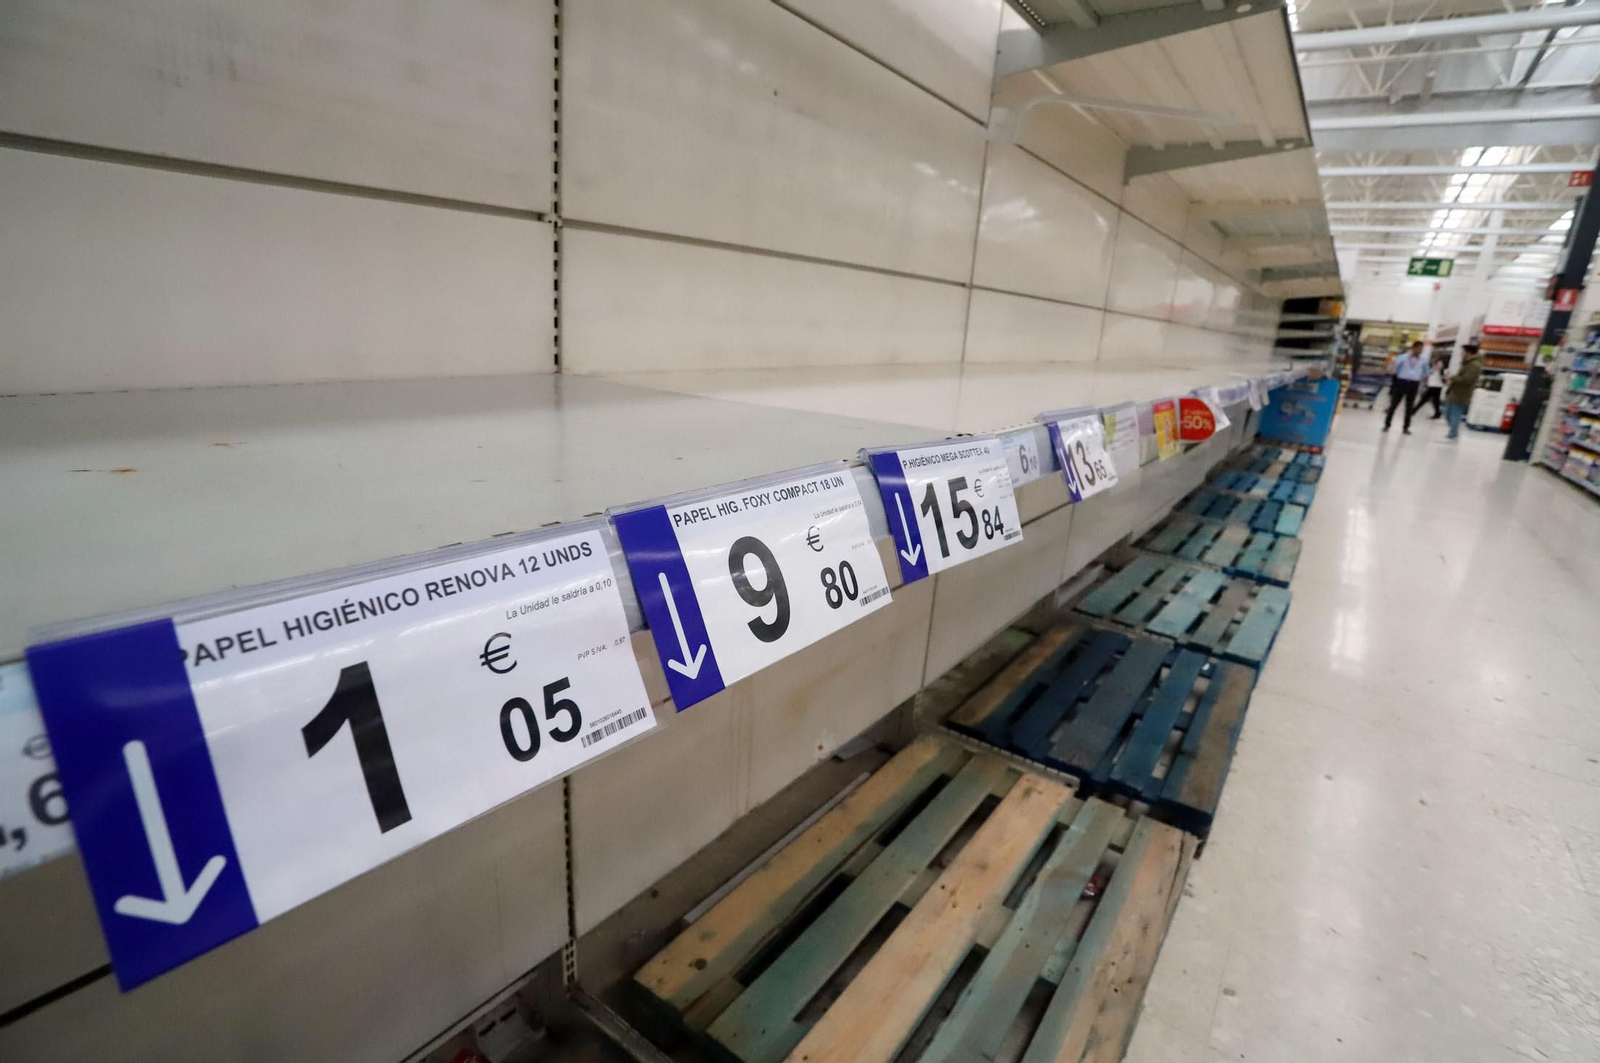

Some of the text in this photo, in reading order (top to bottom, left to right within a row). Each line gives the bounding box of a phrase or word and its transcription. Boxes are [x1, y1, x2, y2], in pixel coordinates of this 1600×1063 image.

[941, 452, 959, 463] MEGA
[1019, 444, 1029, 474] 6
[1067, 440, 1096, 491] 13
[1094, 460, 1108, 481] 65
[672, 476, 844, 528] PAPEL HIG. FOXY COMPACT 18 UN
[973, 478, 985, 498] €
[805, 526, 824, 552] €
[920, 476, 979, 559] 15
[981, 505, 1004, 540] 84
[282, 587, 420, 641] HIGIÉNICO
[424, 562, 516, 601] RENOVA
[518, 556, 541, 574] 12
[542, 541, 593, 568] UNDS
[505, 609, 518, 620] La
[519, 598, 550, 615] Unidad
[551, 596, 560, 605] le
[588, 585, 595, 593] a
[595, 578, 612, 591] 0,10
[728, 535, 790, 643] 9
[820, 560, 859, 610] 80
[479, 631, 518, 675] €
[577, 650, 590, 661] PVP
[499, 676, 583, 763] 05
[300, 660, 413, 835] 1
